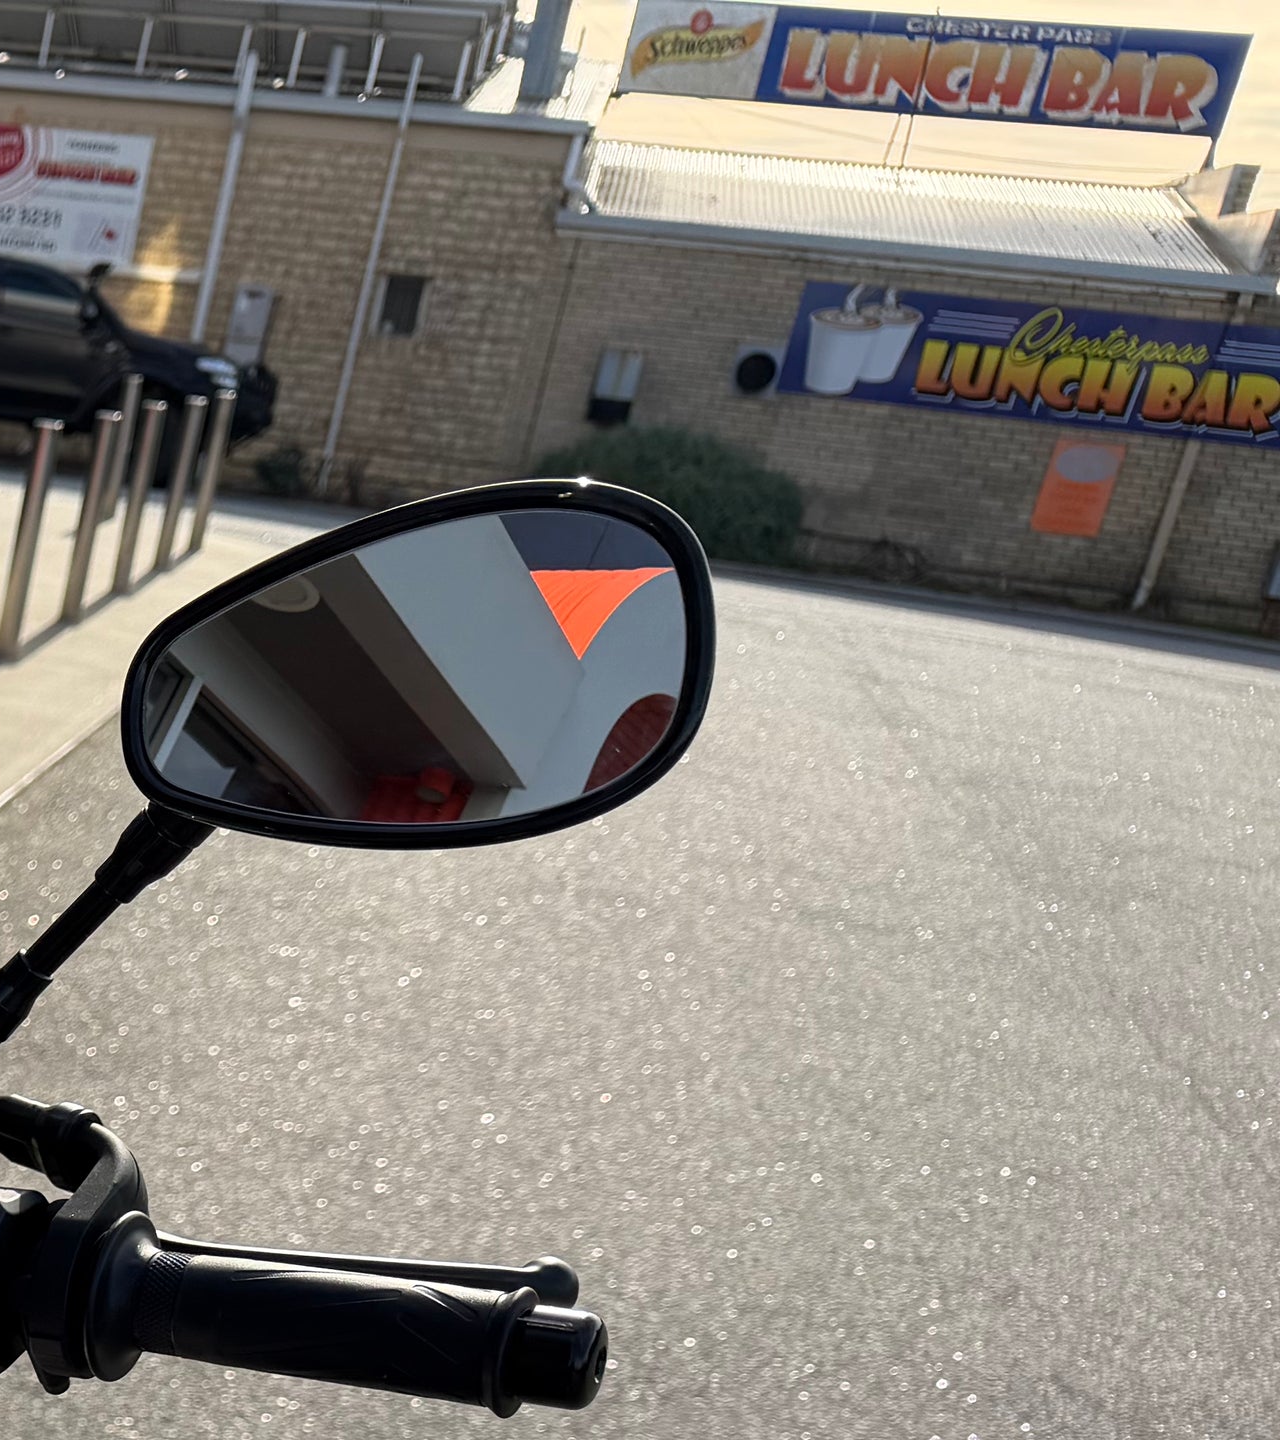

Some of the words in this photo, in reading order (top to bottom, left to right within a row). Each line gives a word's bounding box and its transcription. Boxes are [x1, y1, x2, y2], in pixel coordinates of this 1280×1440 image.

[649, 31, 746, 60] Schweppes
[905, 16, 1030, 42] CHESTER
[1037, 26, 1112, 45] PASS
[779, 27, 1046, 117] LUNCH
[1042, 44, 1218, 131] BAR
[1010, 307, 1210, 374] Chesterpass
[914, 339, 1140, 421] LUNCH
[1140, 363, 1280, 437] BAR
